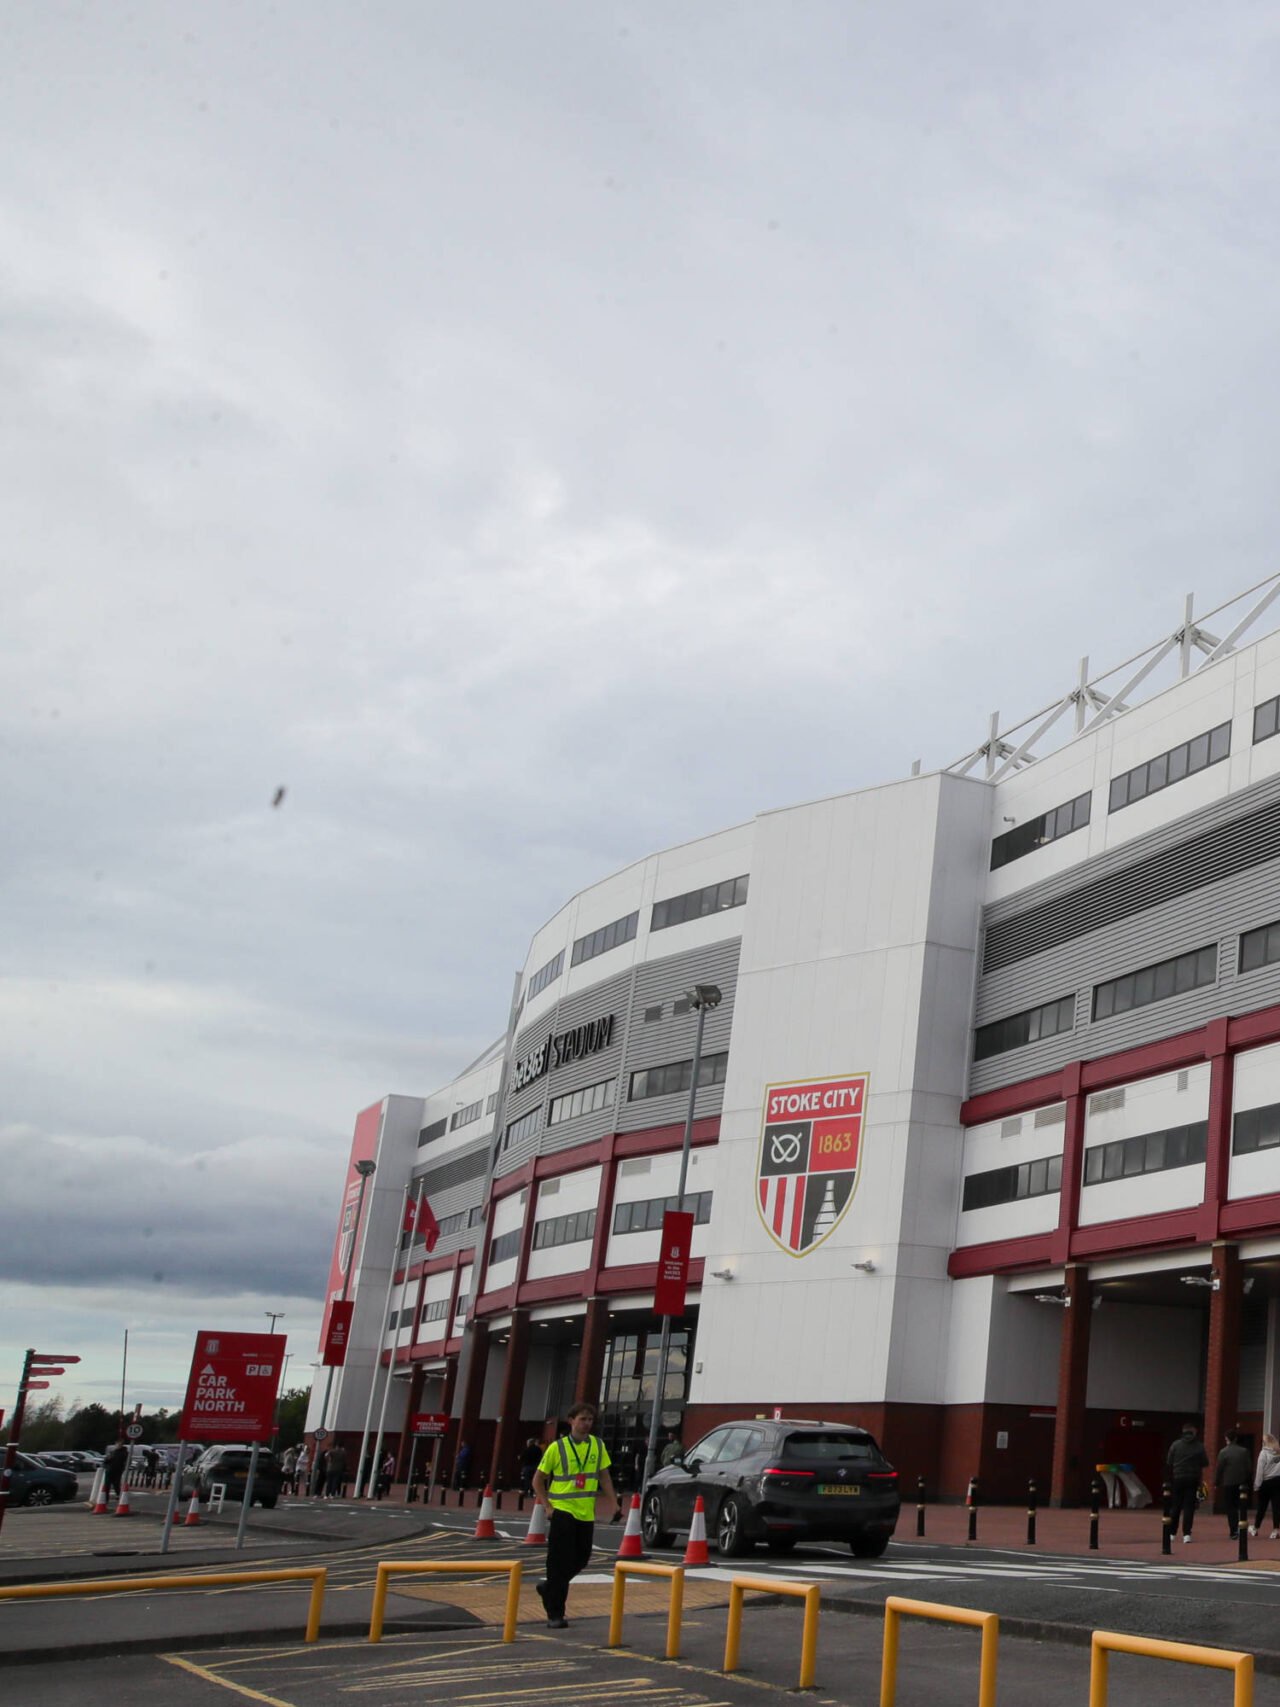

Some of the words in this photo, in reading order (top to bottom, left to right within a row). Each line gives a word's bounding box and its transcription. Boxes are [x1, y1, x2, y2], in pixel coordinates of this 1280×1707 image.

[552, 1013, 615, 1069] STADIUM
[770, 1091, 822, 1115] STOKE
[823, 1087, 860, 1109] CITY
[818, 1132, 852, 1154] 1863
[198, 1375, 228, 1387] CAR
[195, 1387, 236, 1400] PARK
[193, 1400, 246, 1412] NORTH
[130, 1426, 140, 1434] 10
